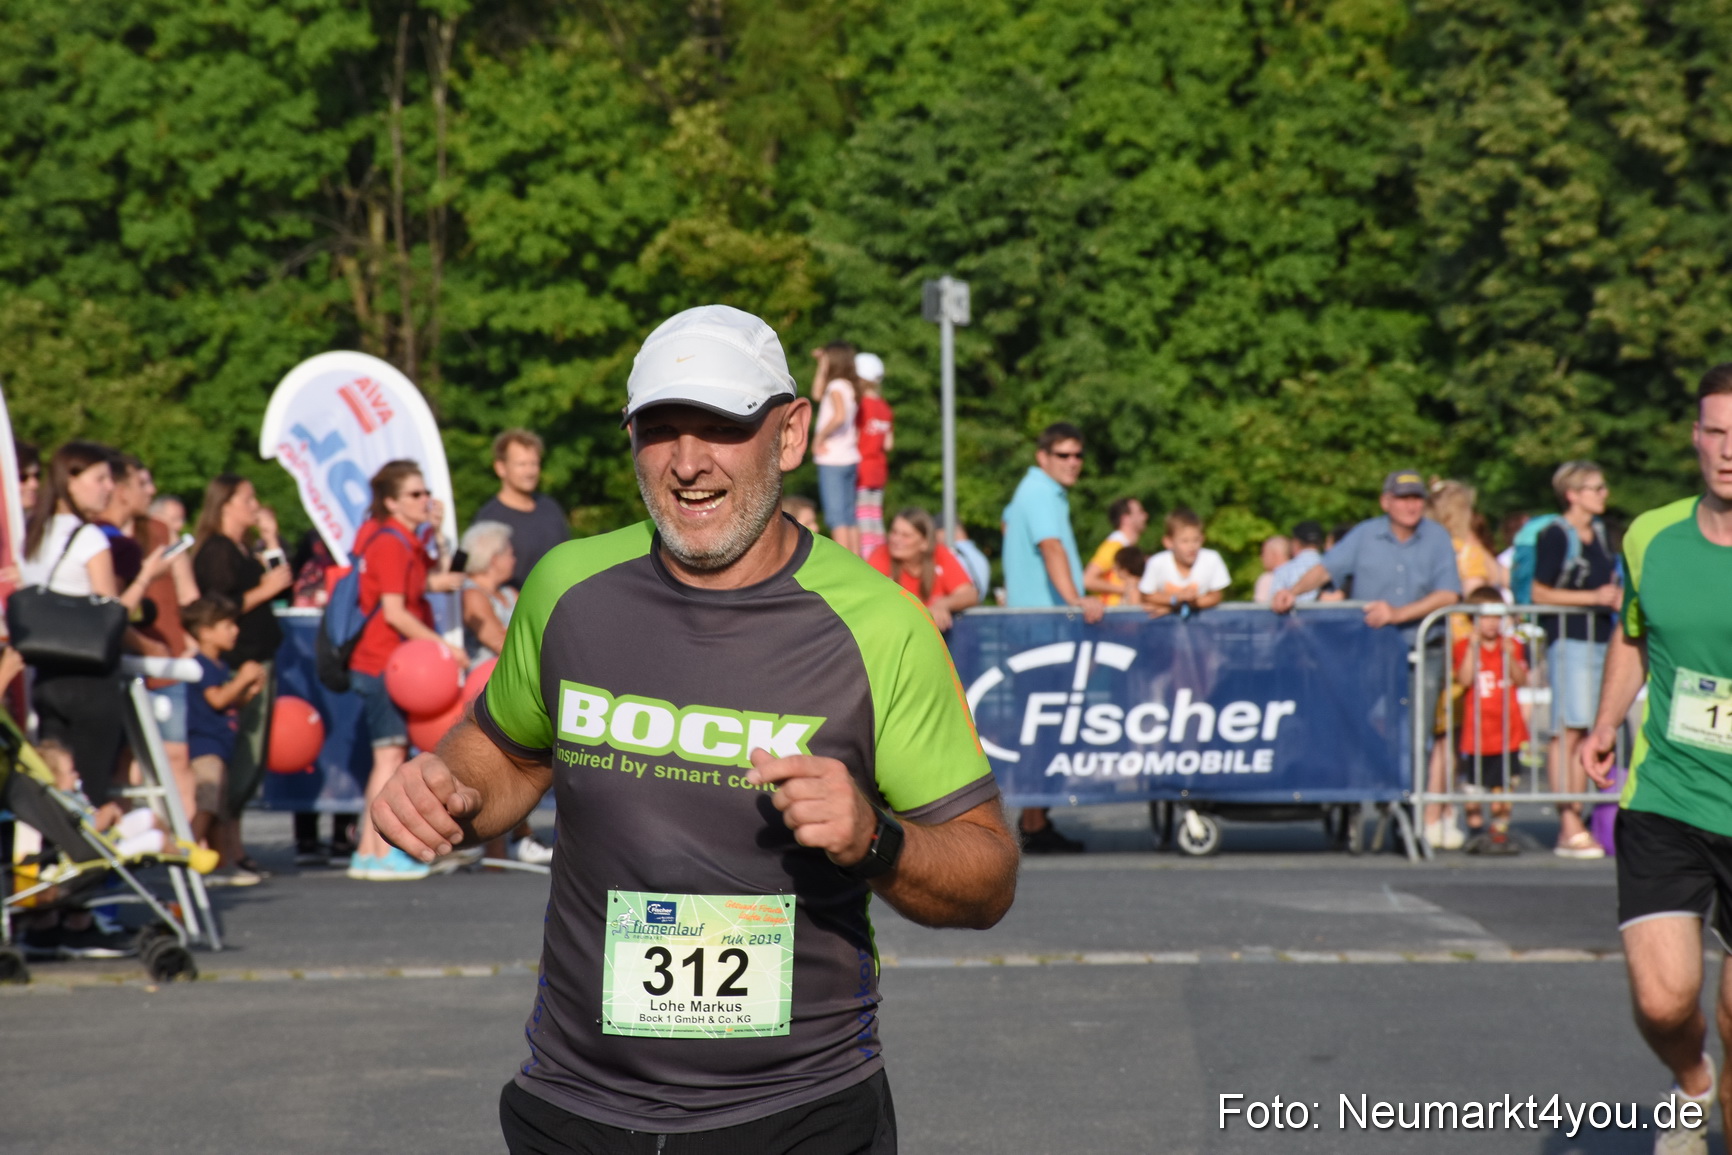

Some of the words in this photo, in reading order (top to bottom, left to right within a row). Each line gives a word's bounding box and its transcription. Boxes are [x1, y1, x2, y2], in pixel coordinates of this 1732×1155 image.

[560, 688, 812, 762] BOCK
[1020, 687, 1297, 746] Fischer
[556, 743, 615, 772] inspired
[620, 755, 648, 779] by
[653, 765, 722, 787] smart
[1045, 748, 1275, 777] AUTOMOBILE
[633, 920, 705, 936] firmenlauf
[749, 933, 782, 945] 2019
[643, 946, 749, 997] 312
[639, 1014, 663, 1023] Bock
[675, 1014, 705, 1024] GmbH
[708, 1015, 715, 1024] &
[718, 1015, 734, 1024] Co.
[737, 1014, 752, 1023] KG
[650, 999, 685, 1012] Lohe
[690, 999, 742, 1013] Markus
